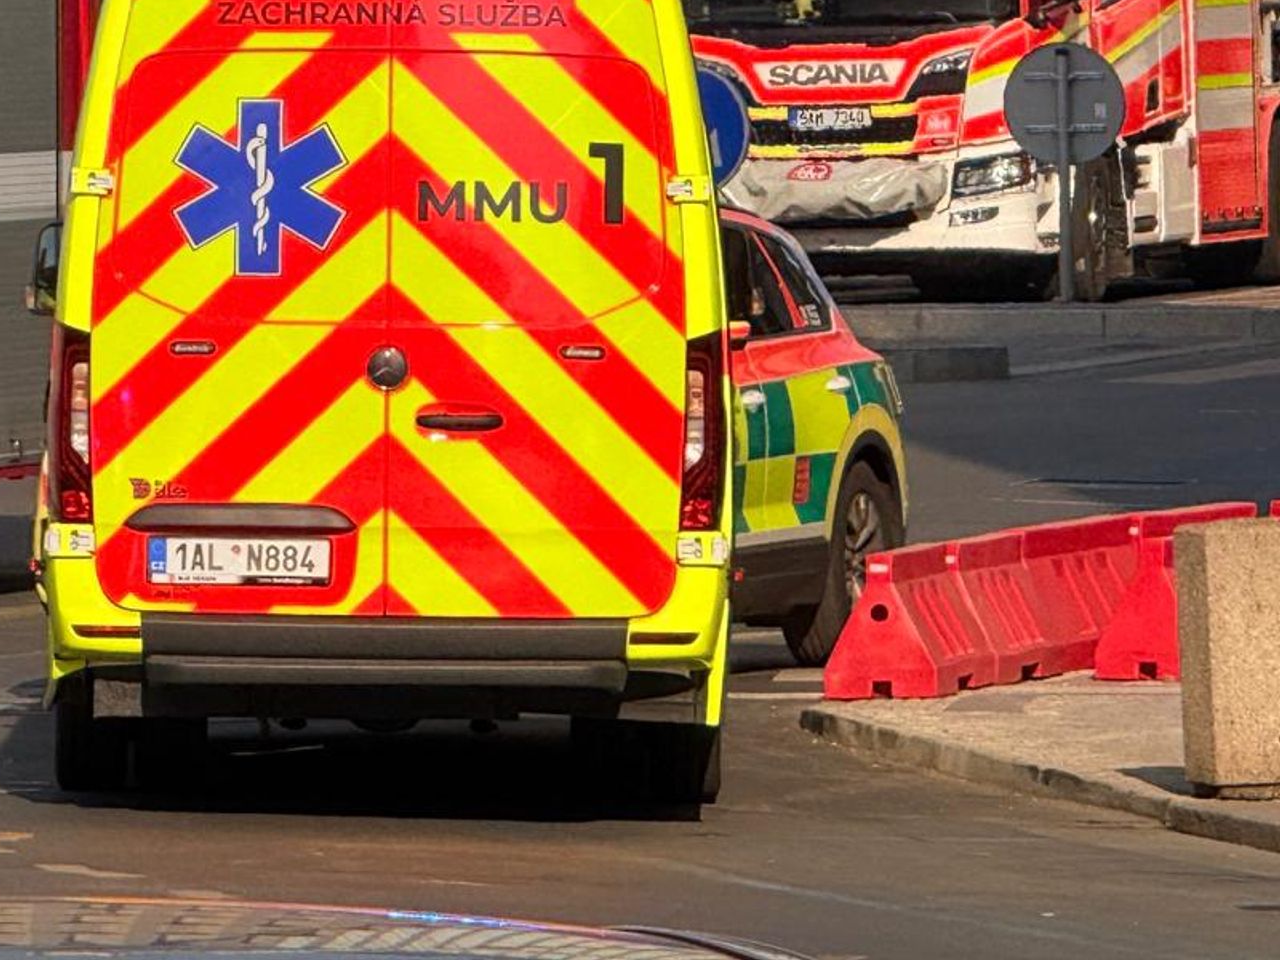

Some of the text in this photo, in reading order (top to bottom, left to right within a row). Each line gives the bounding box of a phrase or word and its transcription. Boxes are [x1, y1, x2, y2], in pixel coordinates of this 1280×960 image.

[437, 0, 567, 28] SLUŽBA
[768, 62, 891, 86] SCANIA
[418, 142, 625, 225] MMU 1
[176, 542, 224, 572] 1AL
[246, 543, 316, 573] N884
